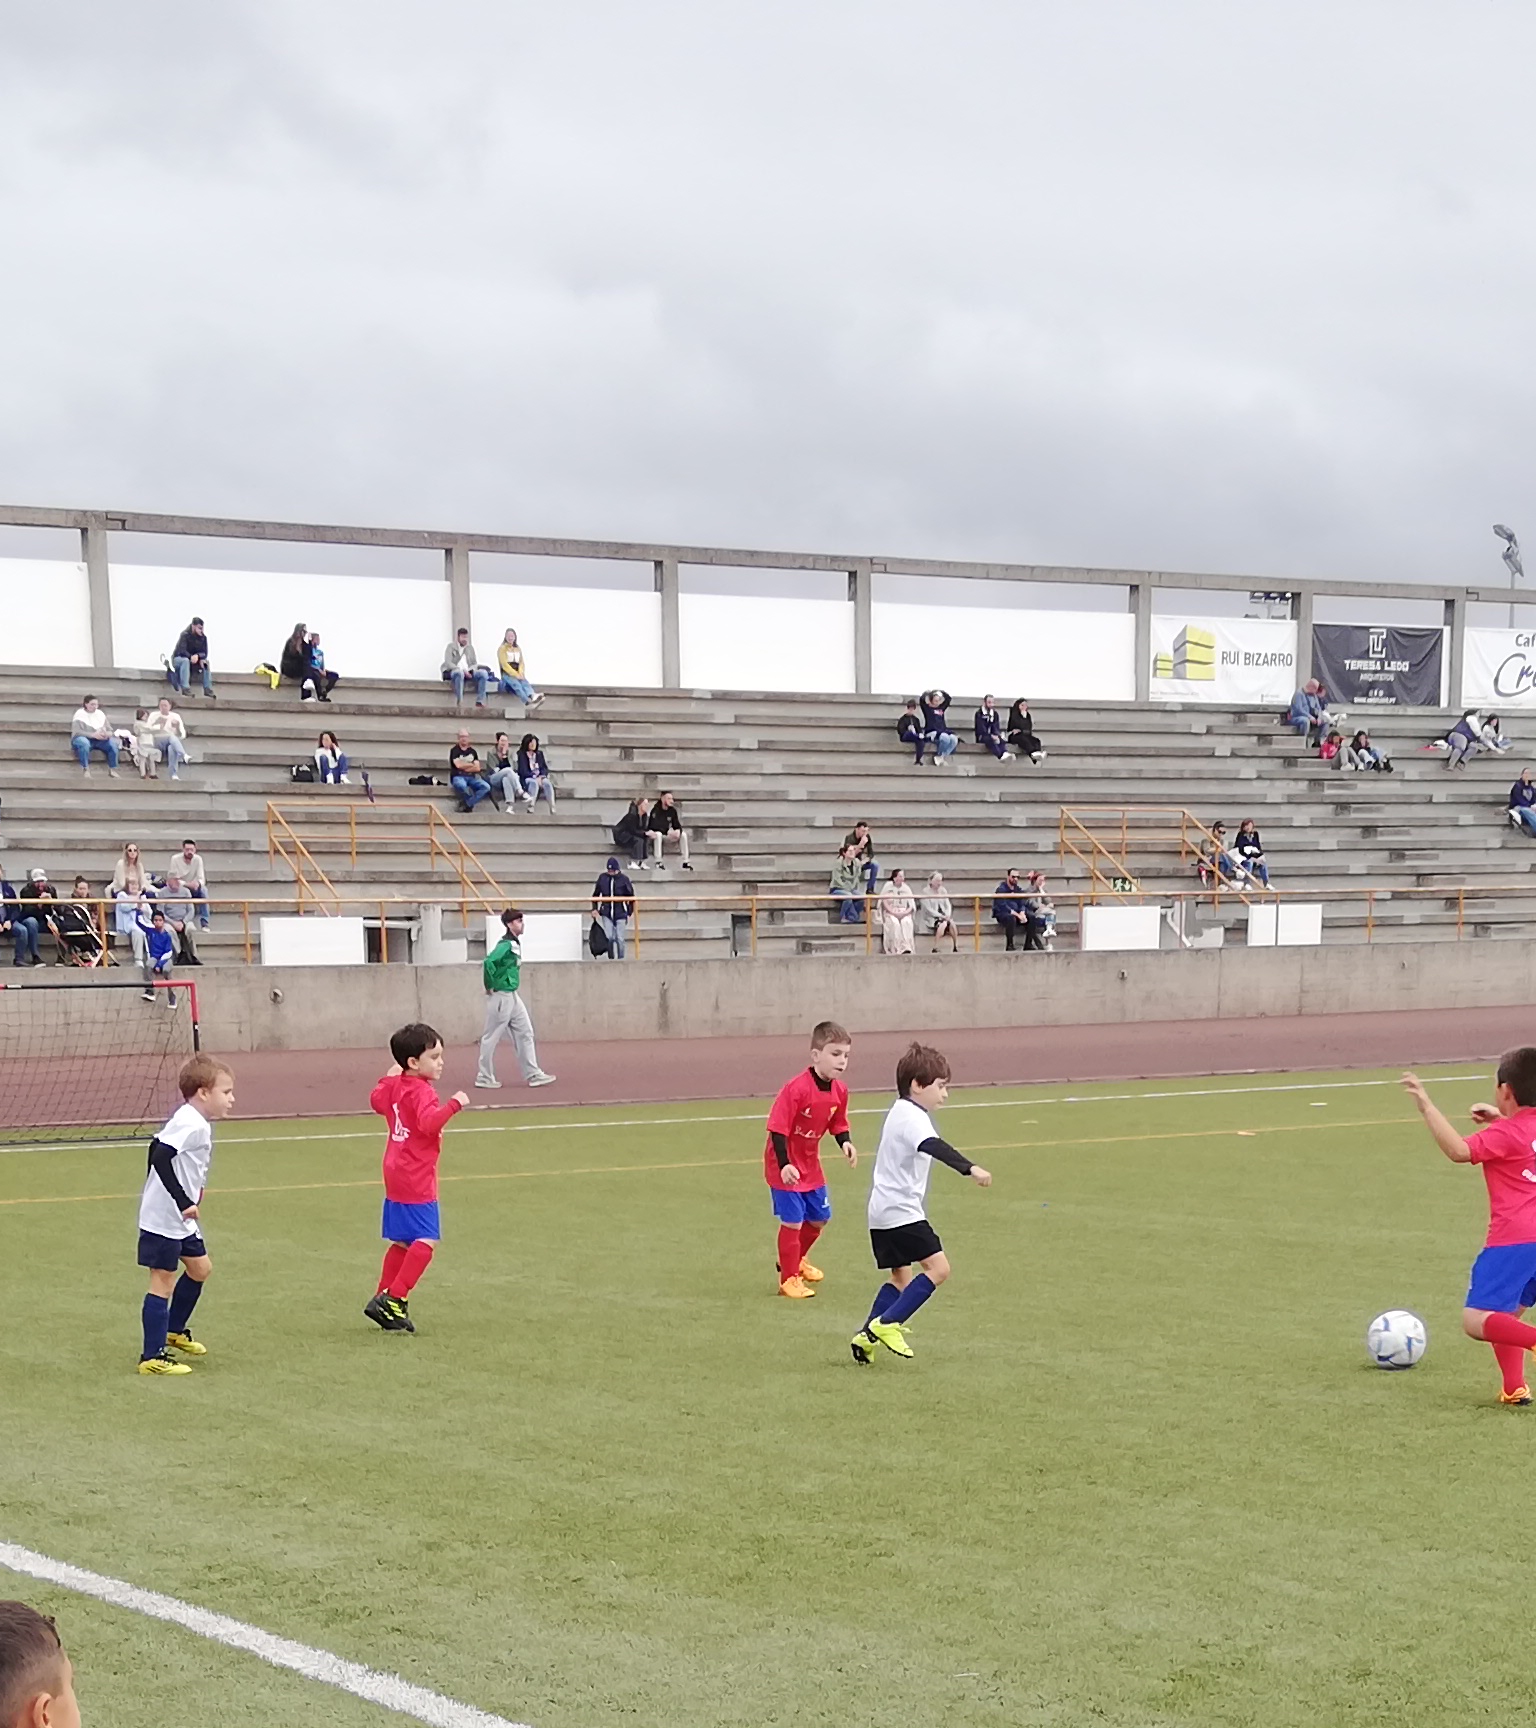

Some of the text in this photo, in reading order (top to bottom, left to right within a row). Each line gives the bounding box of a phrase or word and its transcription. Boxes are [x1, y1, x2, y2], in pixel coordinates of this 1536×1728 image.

[1221, 651, 1293, 667] RUI BIZARRO
[1344, 660, 1381, 670] TERESA
